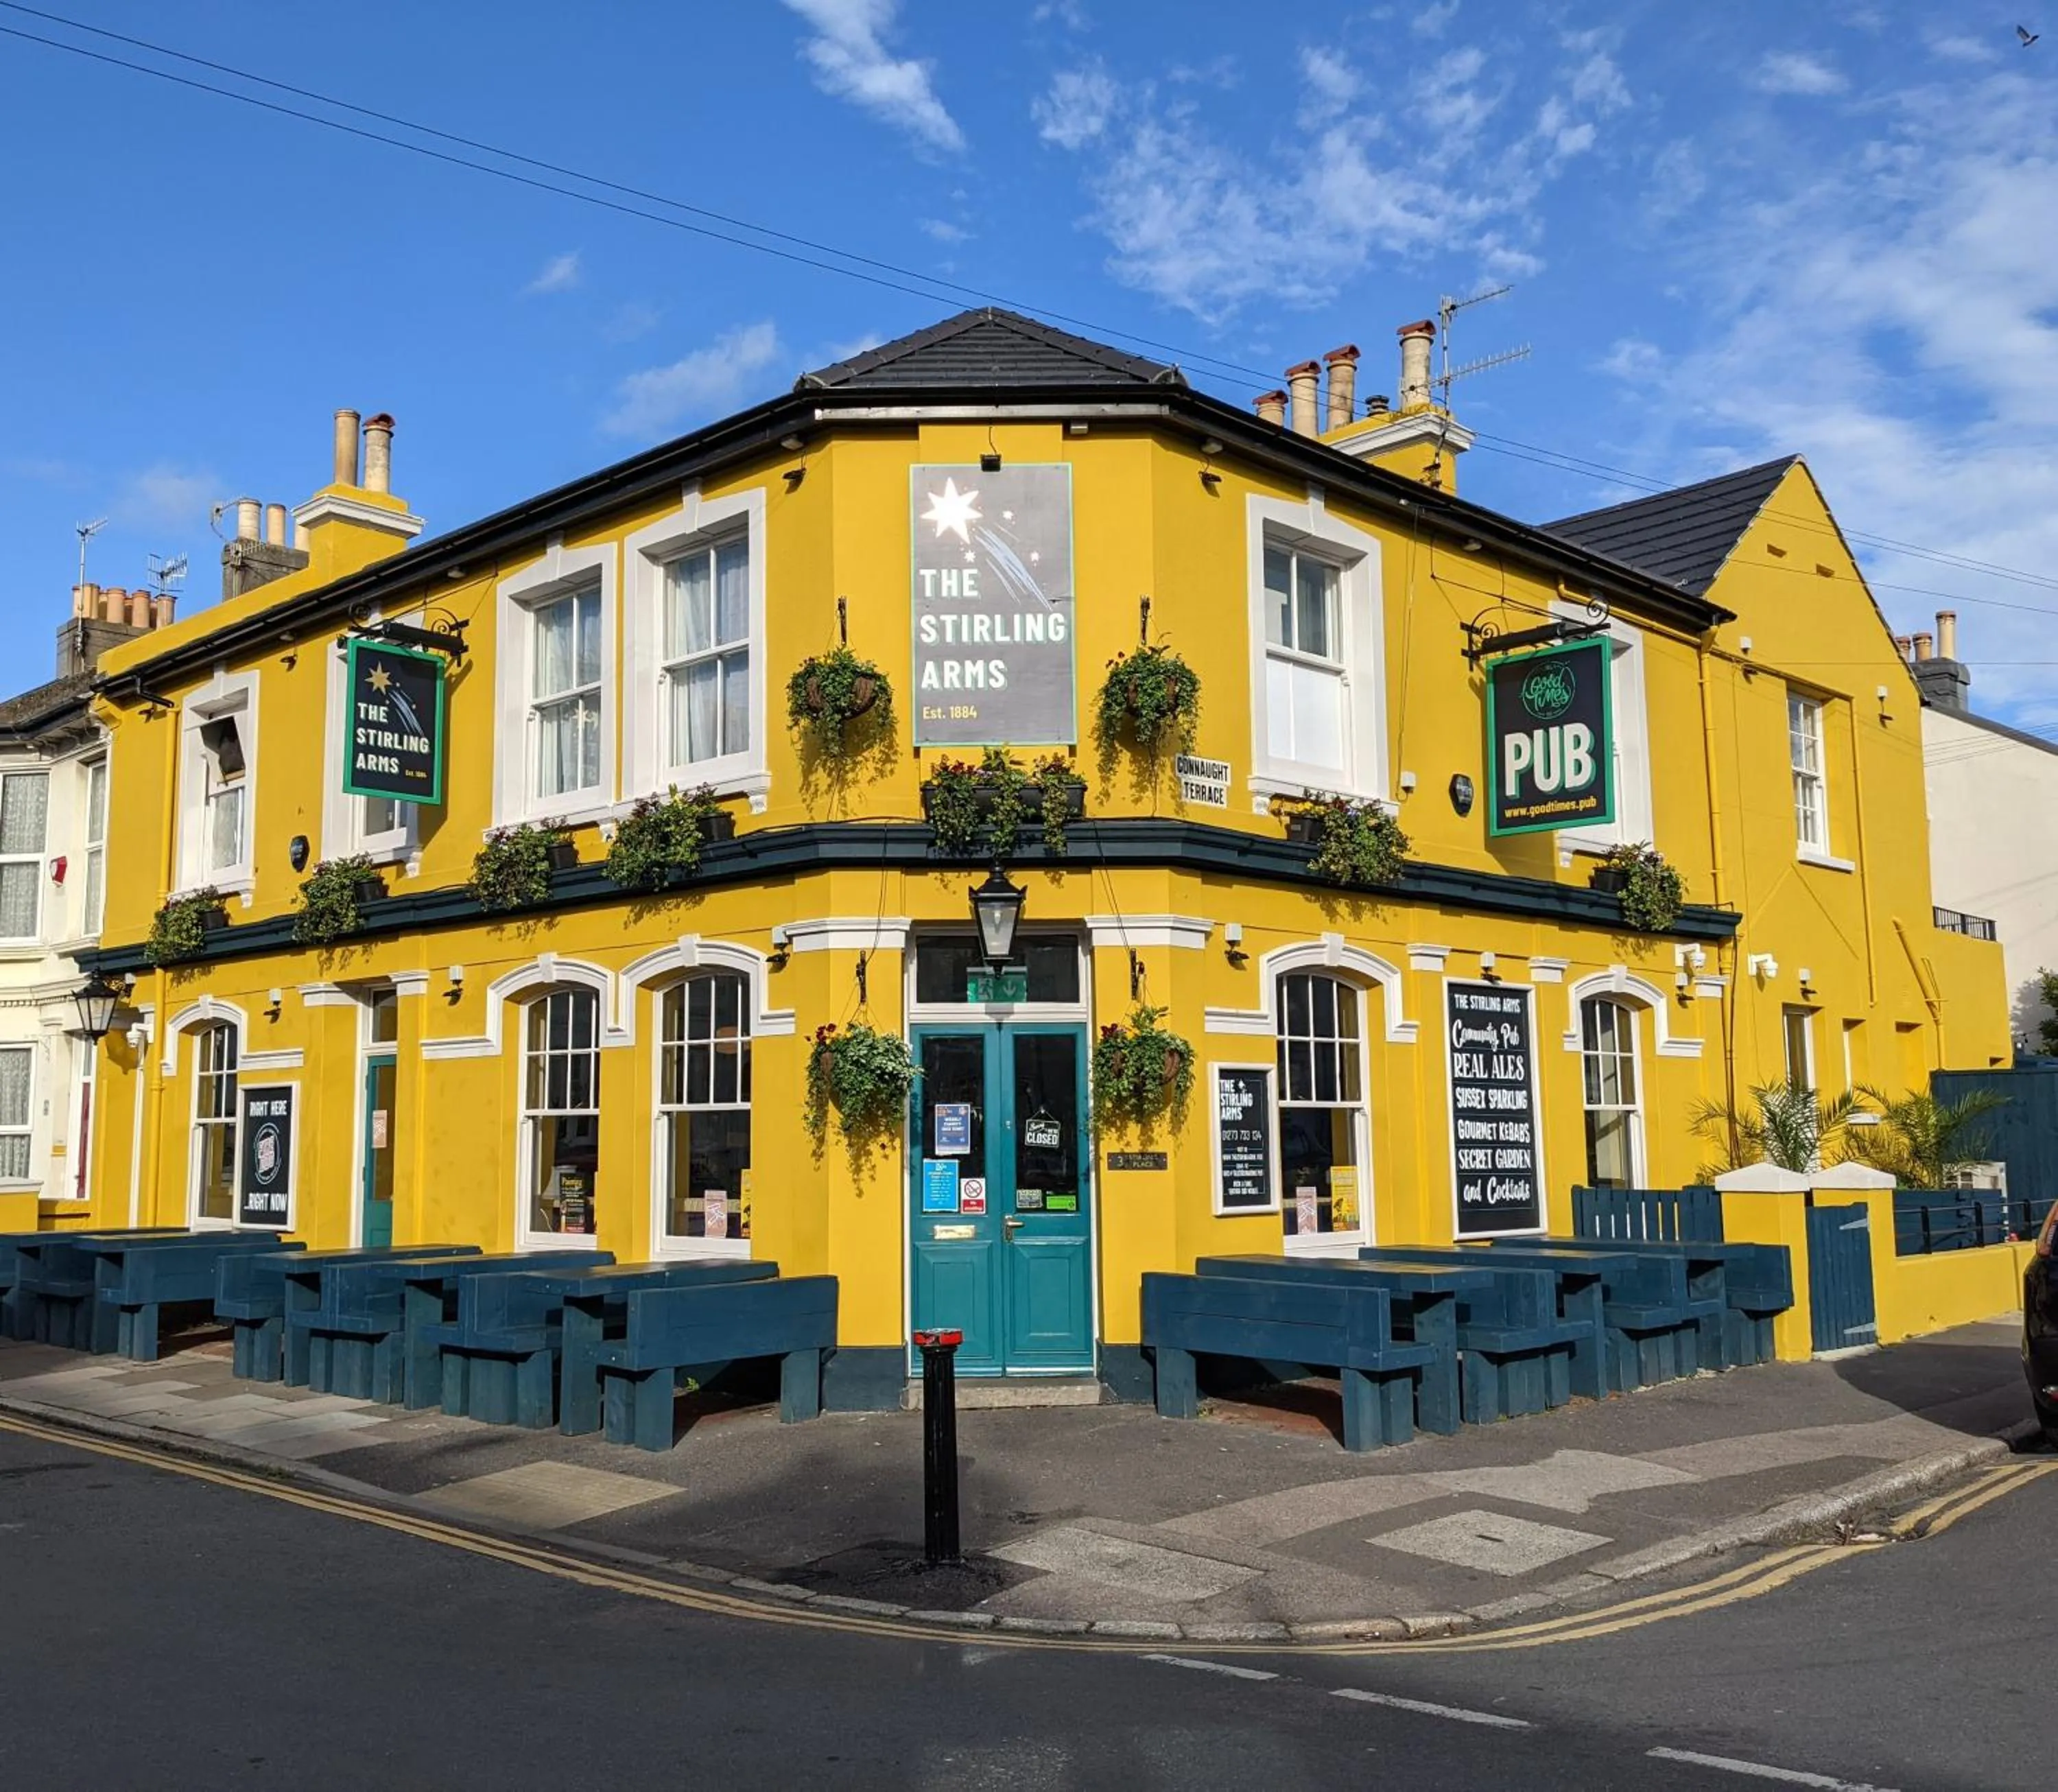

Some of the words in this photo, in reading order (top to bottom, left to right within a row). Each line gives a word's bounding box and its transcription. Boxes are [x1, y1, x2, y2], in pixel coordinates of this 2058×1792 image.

[919, 568, 980, 598] THE
[920, 613, 1065, 644] STIRLING
[921, 659, 1006, 689] ARMS
[357, 703, 389, 723] THE
[923, 705, 946, 720] Est.
[949, 705, 977, 720] 1884
[357, 728, 429, 754] STIRLING
[357, 753, 400, 774] ARMS
[1177, 757, 1229, 781] CONNAUGHT
[1504, 722, 1594, 797] PUB
[1184, 781, 1224, 805] TERRACE
[1504, 797, 1597, 818] www.goodtimes.pub
[1454, 993, 1469, 1009] THE
[1470, 995, 1501, 1012] STIRLING
[1502, 998, 1521, 1013] ARMS
[1452, 1019, 1499, 1052] Community
[1500, 1023, 1519, 1049] Pub
[1453, 1052, 1488, 1078] REAL
[1491, 1054, 1524, 1081] ALES
[1220, 1079, 1235, 1093] THE
[249, 1100, 268, 1117] RIGHT
[270, 1100, 287, 1116] HERE
[1220, 1093, 1253, 1107] STIRLING
[1455, 1087, 1486, 1109] SUSSEX
[1488, 1089, 1528, 1110] SPARKLING
[1221, 1107, 1242, 1120] ARMS
[1027, 1132, 1058, 1145] CLOSED
[1458, 1119, 1497, 1140] GOURMET
[1458, 1148, 1493, 1169] SECRET
[1495, 1148, 1532, 1169] GARDEN
[1463, 1179, 1482, 1202] and
[1487, 1176, 1530, 1204] Cocktails
[270, 1192, 287, 1212] NOW
